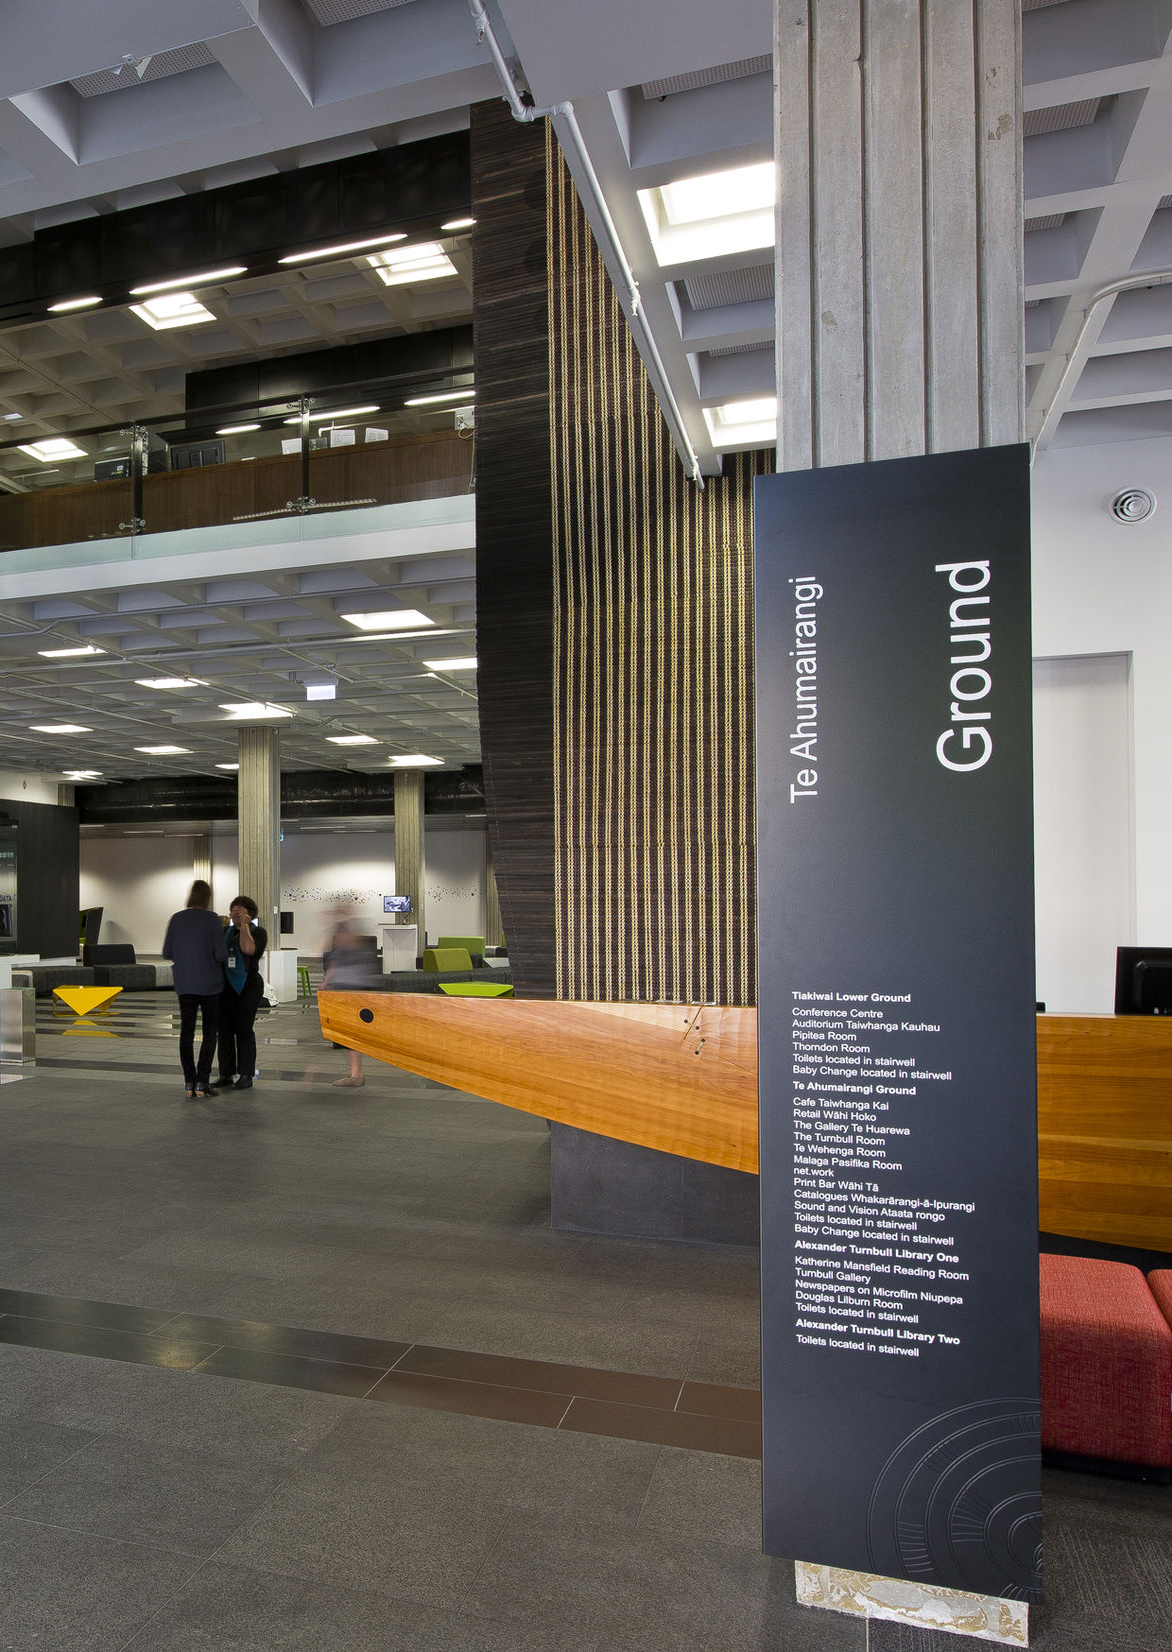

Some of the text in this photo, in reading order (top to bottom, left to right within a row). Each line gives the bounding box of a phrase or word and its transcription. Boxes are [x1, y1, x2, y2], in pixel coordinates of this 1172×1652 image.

[935, 560, 993, 772] Ground
[788, 576, 824, 804] Te Ahumairangi
[791, 990, 911, 1003] Tiakiwai Lower Ground
[792, 1006, 883, 1018] Conference Centre
[791, 1017, 940, 1033] Auditorium Taiwhanga Kauhau
[792, 1029, 856, 1041] Pipitea Room
[792, 1040, 870, 1053] Thorndon Room
[792, 1052, 915, 1067] Toilets located in stairwell
[792, 1064, 952, 1081] Baby Change located in stairwell
[792, 1080, 916, 1095] Te Ahumairangi Ground
[792, 1096, 889, 1112] Cafe Taiwhanga Kai
[793, 1107, 820, 1118] Retail
[850, 1110, 876, 1121] Hoko
[793, 1119, 910, 1135] The Gallery Te Huarewa
[793, 1130, 885, 1145] The Turnbull Room
[793, 1142, 886, 1158] Te Wehenga Room
[793, 1153, 902, 1171] Malaga Pasifika Room
[793, 1165, 834, 1177] net.work
[793, 1176, 816, 1187] Print
[818, 1178, 836, 1188] Bar
[793, 1188, 848, 1203] Catalogues
[794, 1199, 945, 1223] Sound and Vision Ataata rongo
[794, 1211, 917, 1231] Toilets located in stairwell
[794, 1222, 954, 1246] Baby Change located in stairwell
[794, 1238, 959, 1263] Alexander Turnbull Library One
[794, 1266, 871, 1285] Turnbull Gallery
[795, 1254, 969, 1281] Katherine Mansfield Reading Room
[795, 1278, 963, 1307] Newspapers on Microfilm Niupepa
[795, 1289, 903, 1310] Douglas Lilburn Room
[795, 1301, 918, 1324] Toilets located in stairwell
[795, 1317, 960, 1345] Alexander Turnbull Library Two
[795, 1333, 919, 1357] Toilets located in stairwell
